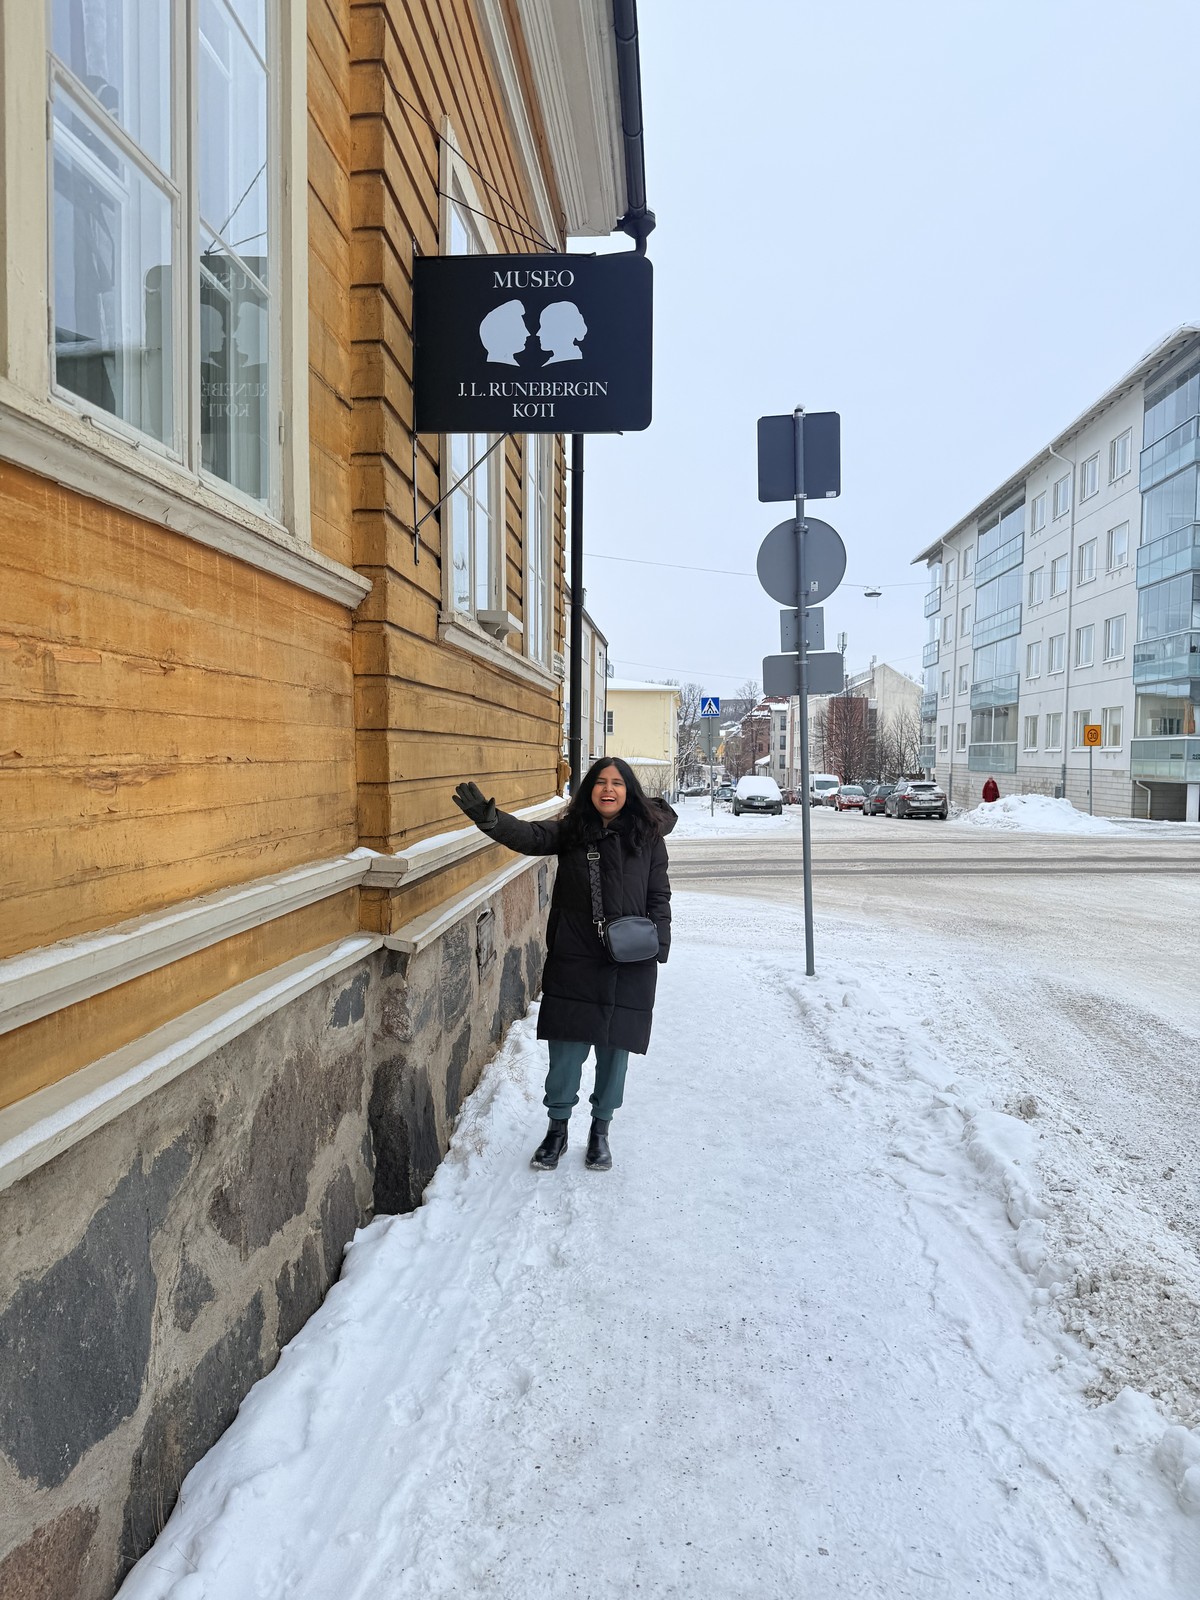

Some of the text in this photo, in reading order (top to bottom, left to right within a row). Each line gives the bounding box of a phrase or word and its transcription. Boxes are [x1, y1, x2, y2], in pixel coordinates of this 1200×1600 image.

[492, 269, 575, 288] MUSEO
[489, 381, 609, 397] RUNEBERGIN
[512, 402, 555, 418] KOTI
[1089, 731, 1097, 740] 30
